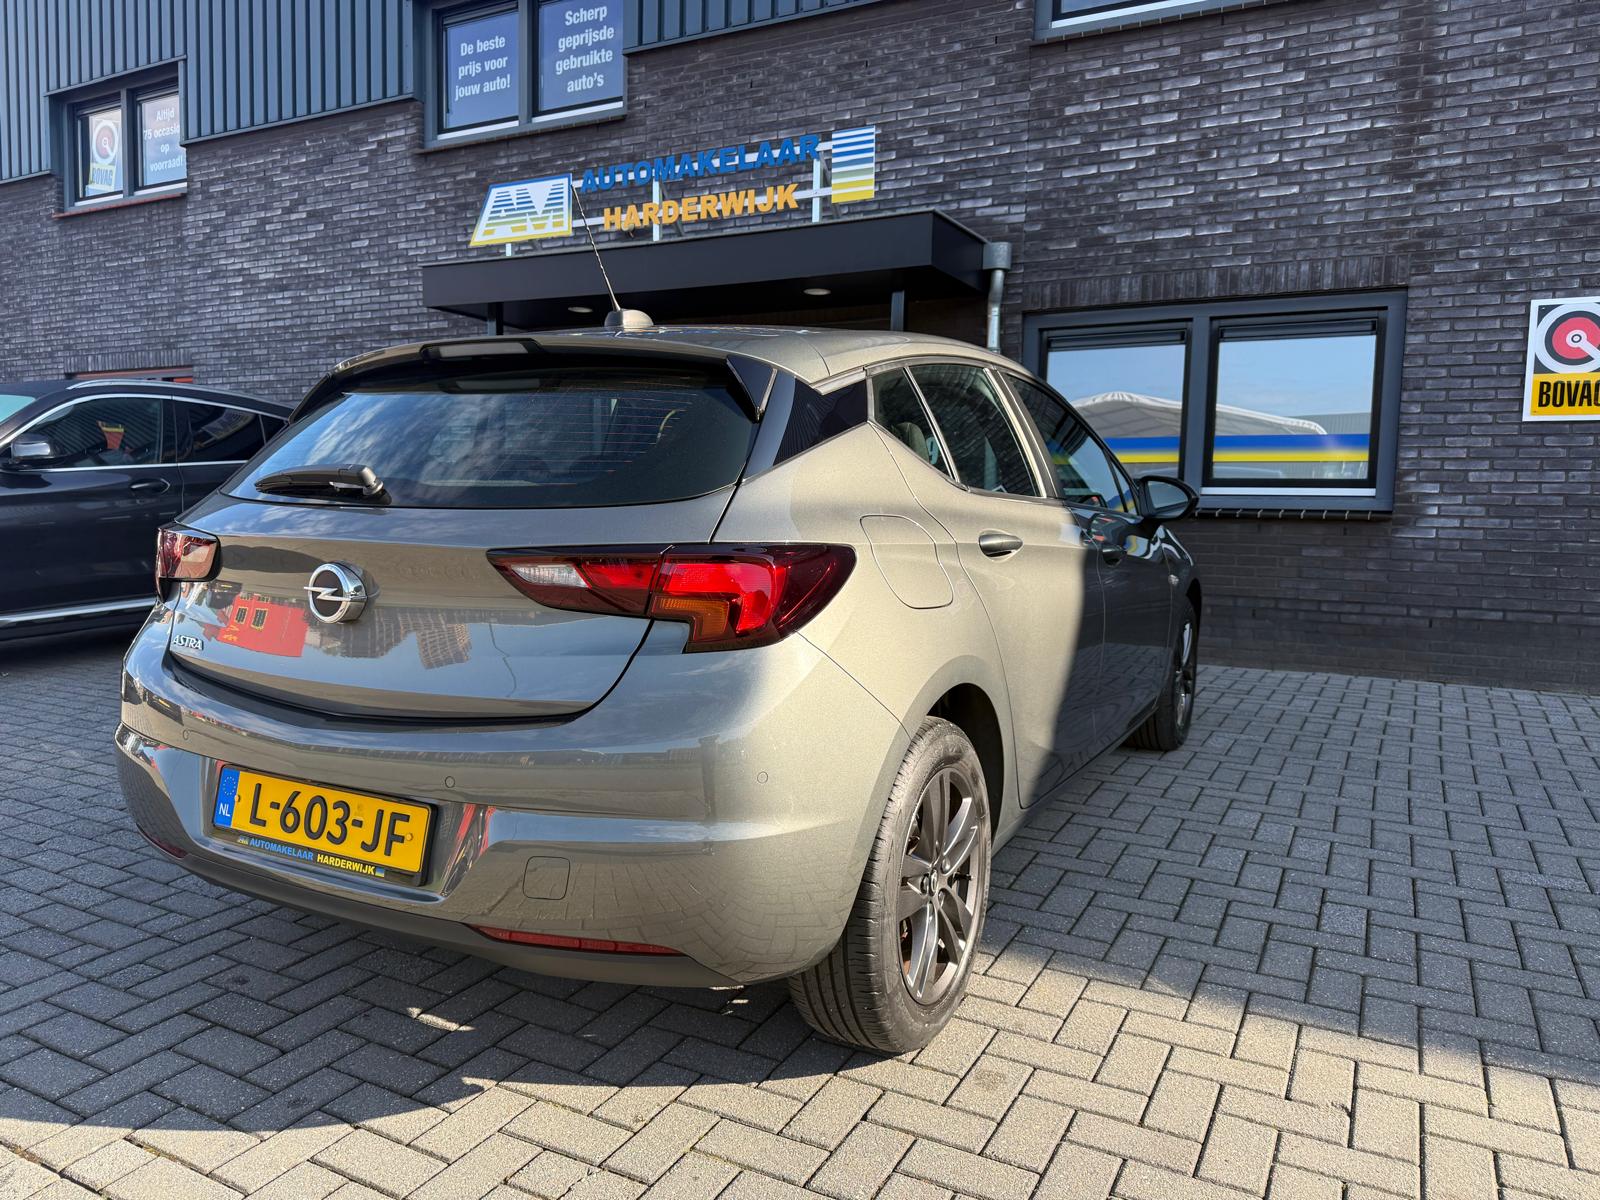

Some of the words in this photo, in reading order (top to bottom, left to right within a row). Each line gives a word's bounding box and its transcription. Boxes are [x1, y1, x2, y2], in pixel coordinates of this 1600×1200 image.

[565, 6, 608, 26] Scherp
[460, 42, 474, 56] De
[476, 36, 506, 53] beste
[558, 26, 615, 52] geprijsde
[458, 60, 482, 80] prijs
[484, 55, 508, 71] voor
[555, 49, 613, 75] gebruikte
[455, 82, 481, 101] jouw
[483, 74, 511, 93] auto!
[567, 72, 605, 93] auto's
[156, 107, 175, 122] Altijd
[160, 143, 170, 155] op
[150, 155, 183, 172] voorraad!
[580, 134, 821, 193] AUTOMAKELAAR
[603, 183, 799, 230] HARDERWIJK
[173, 634, 204, 651] ASTRA
[218, 802, 231, 817] NL
[249, 782, 411, 857] L-603-JF
[250, 837, 313, 861] AUTOMAKELAAR
[317, 853, 376, 876] HARDERWIJK
